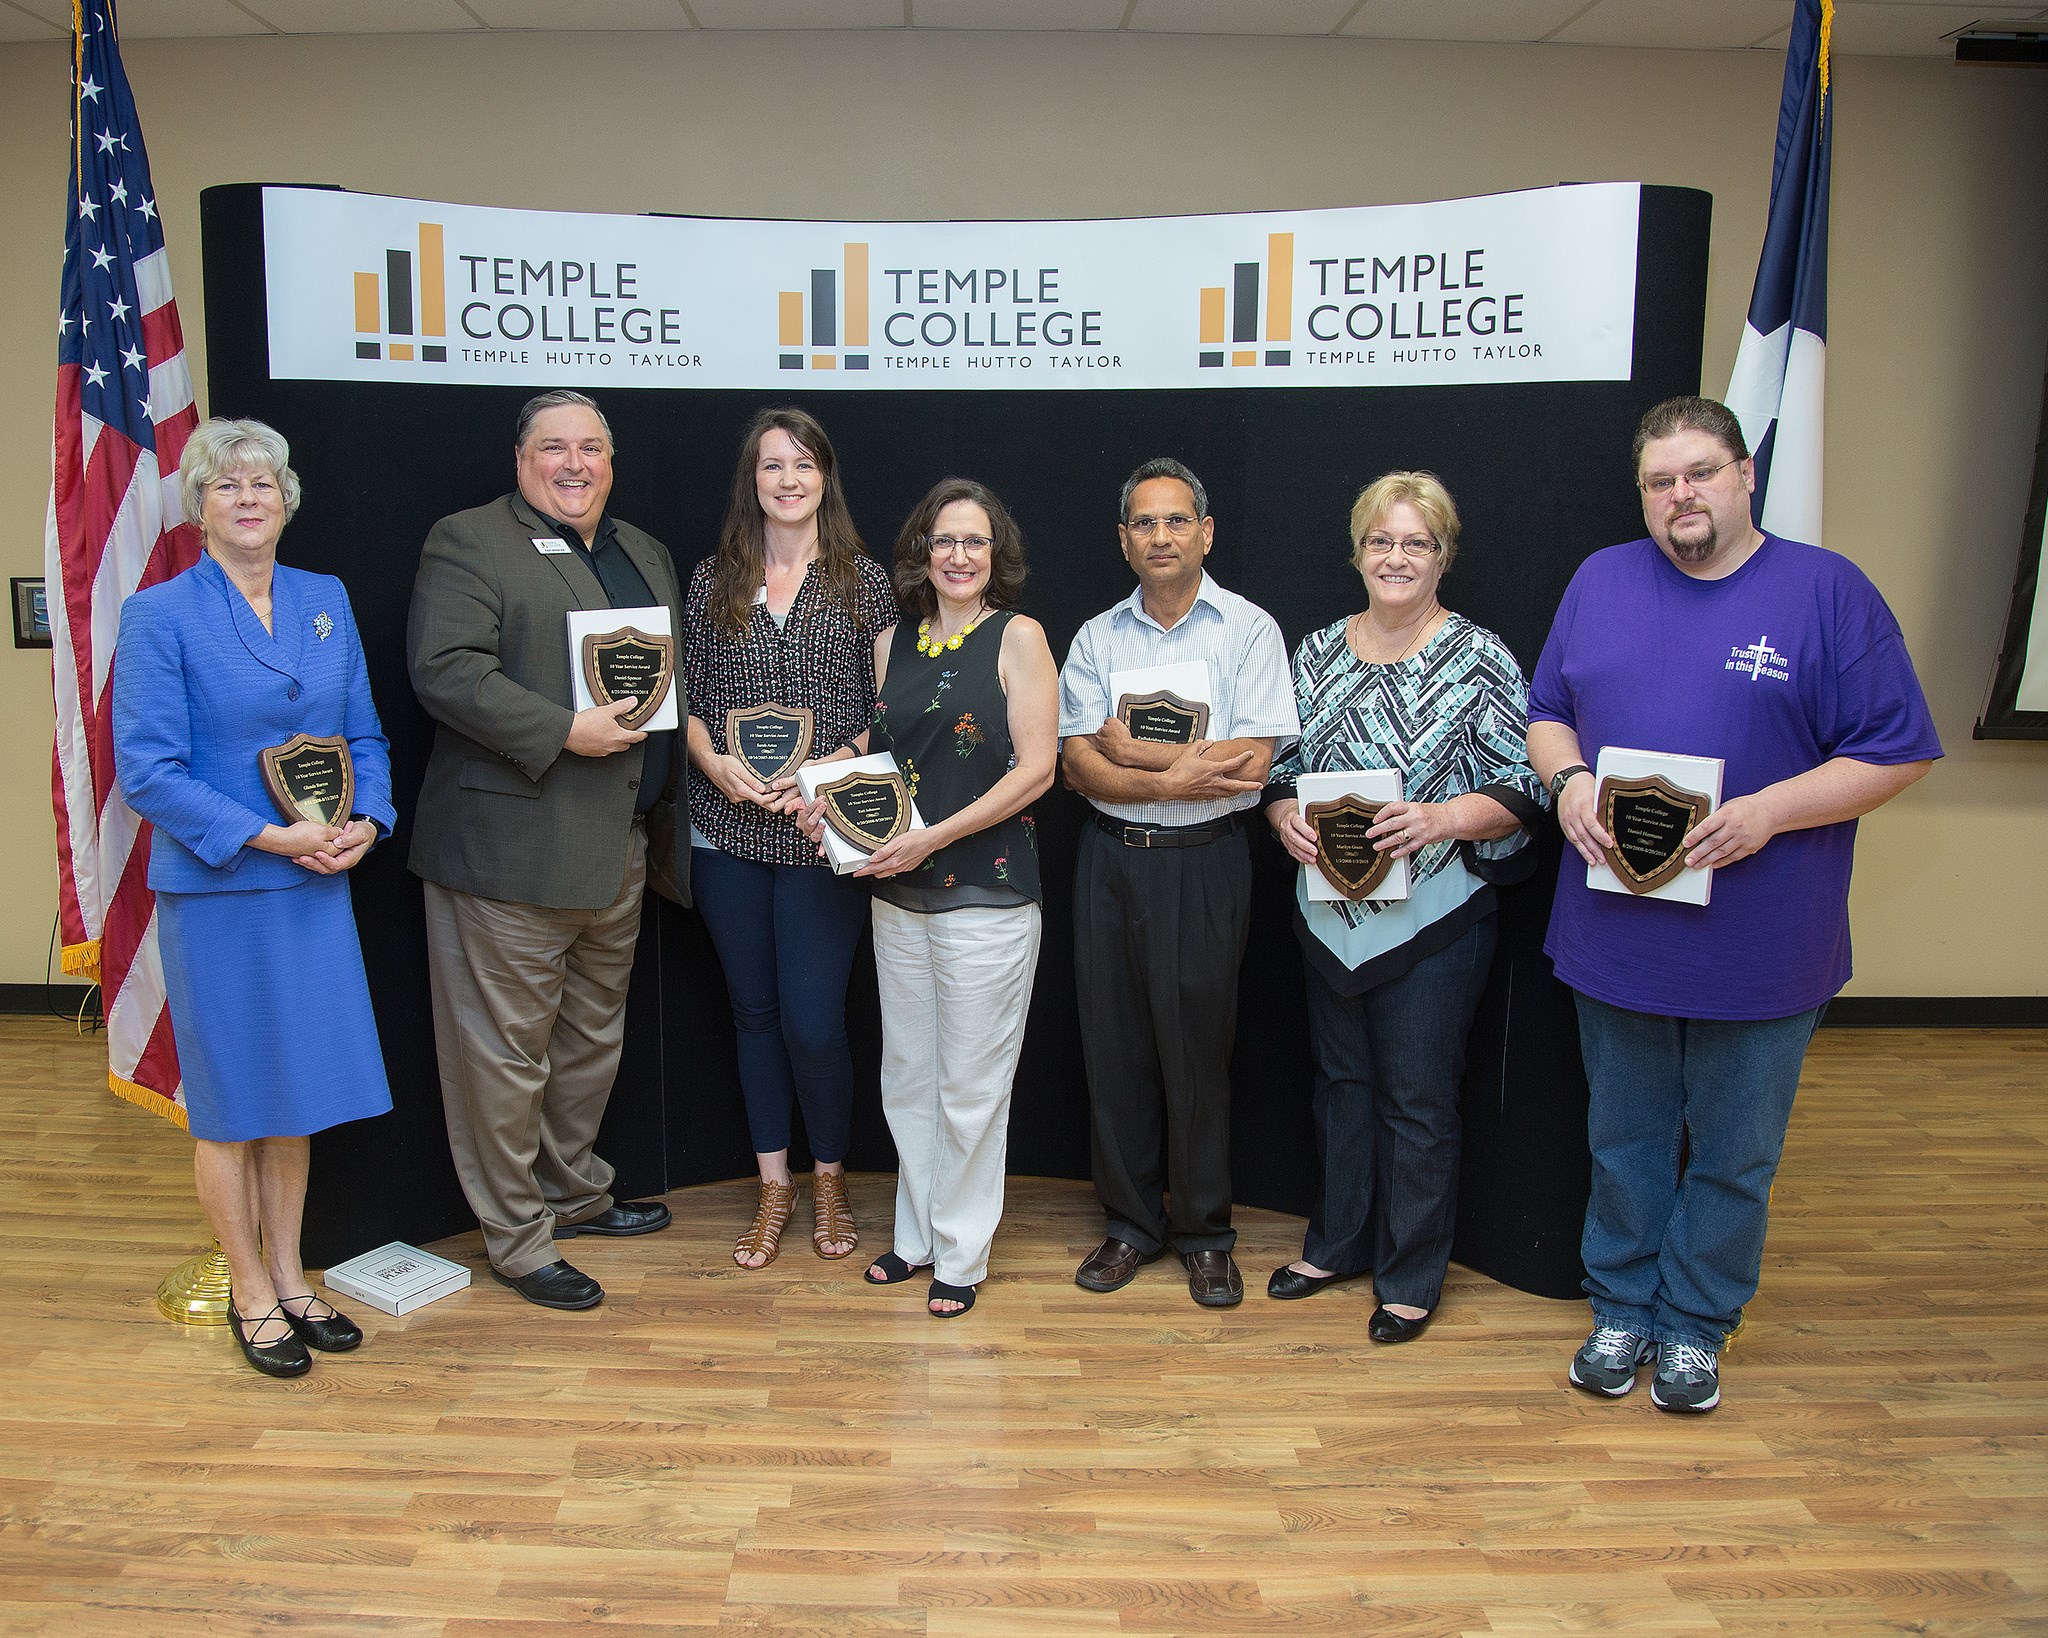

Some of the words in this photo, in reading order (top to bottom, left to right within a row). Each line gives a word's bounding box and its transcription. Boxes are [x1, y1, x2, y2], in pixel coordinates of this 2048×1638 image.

[460, 255, 637, 299] TEMPLE
[1310, 249, 1484, 295] TEMPLE
[885, 269, 1058, 303] TEMPLE
[461, 302, 680, 344] COLLEGE
[885, 312, 1101, 346] COLLEGE
[1308, 297, 1523, 341] COLLEGE
[462, 349, 528, 363] TEMPLE
[547, 352, 611, 365] HUTTO
[629, 354, 701, 366] TAYLOR
[884, 357, 949, 368] TEMPLE
[968, 357, 1031, 368] HUTTO
[1050, 356, 1121, 367] TAYLOR
[1307, 351, 1375, 364] TEMPLE
[1394, 349, 1456, 362] HUTTO
[1473, 344, 1542, 359] TAYLOR
[1731, 646, 1768, 664] Trusting
[1769, 652, 1788, 667] Him
[1725, 658, 1735, 670] in
[1735, 660, 1754, 672] this
[1756, 664, 1789, 682] Season
[1634, 804, 1650, 813] Temple
[1650, 808, 1669, 817] College
[1642, 818, 1659, 826] Service
[1659, 821, 1675, 829] Award
